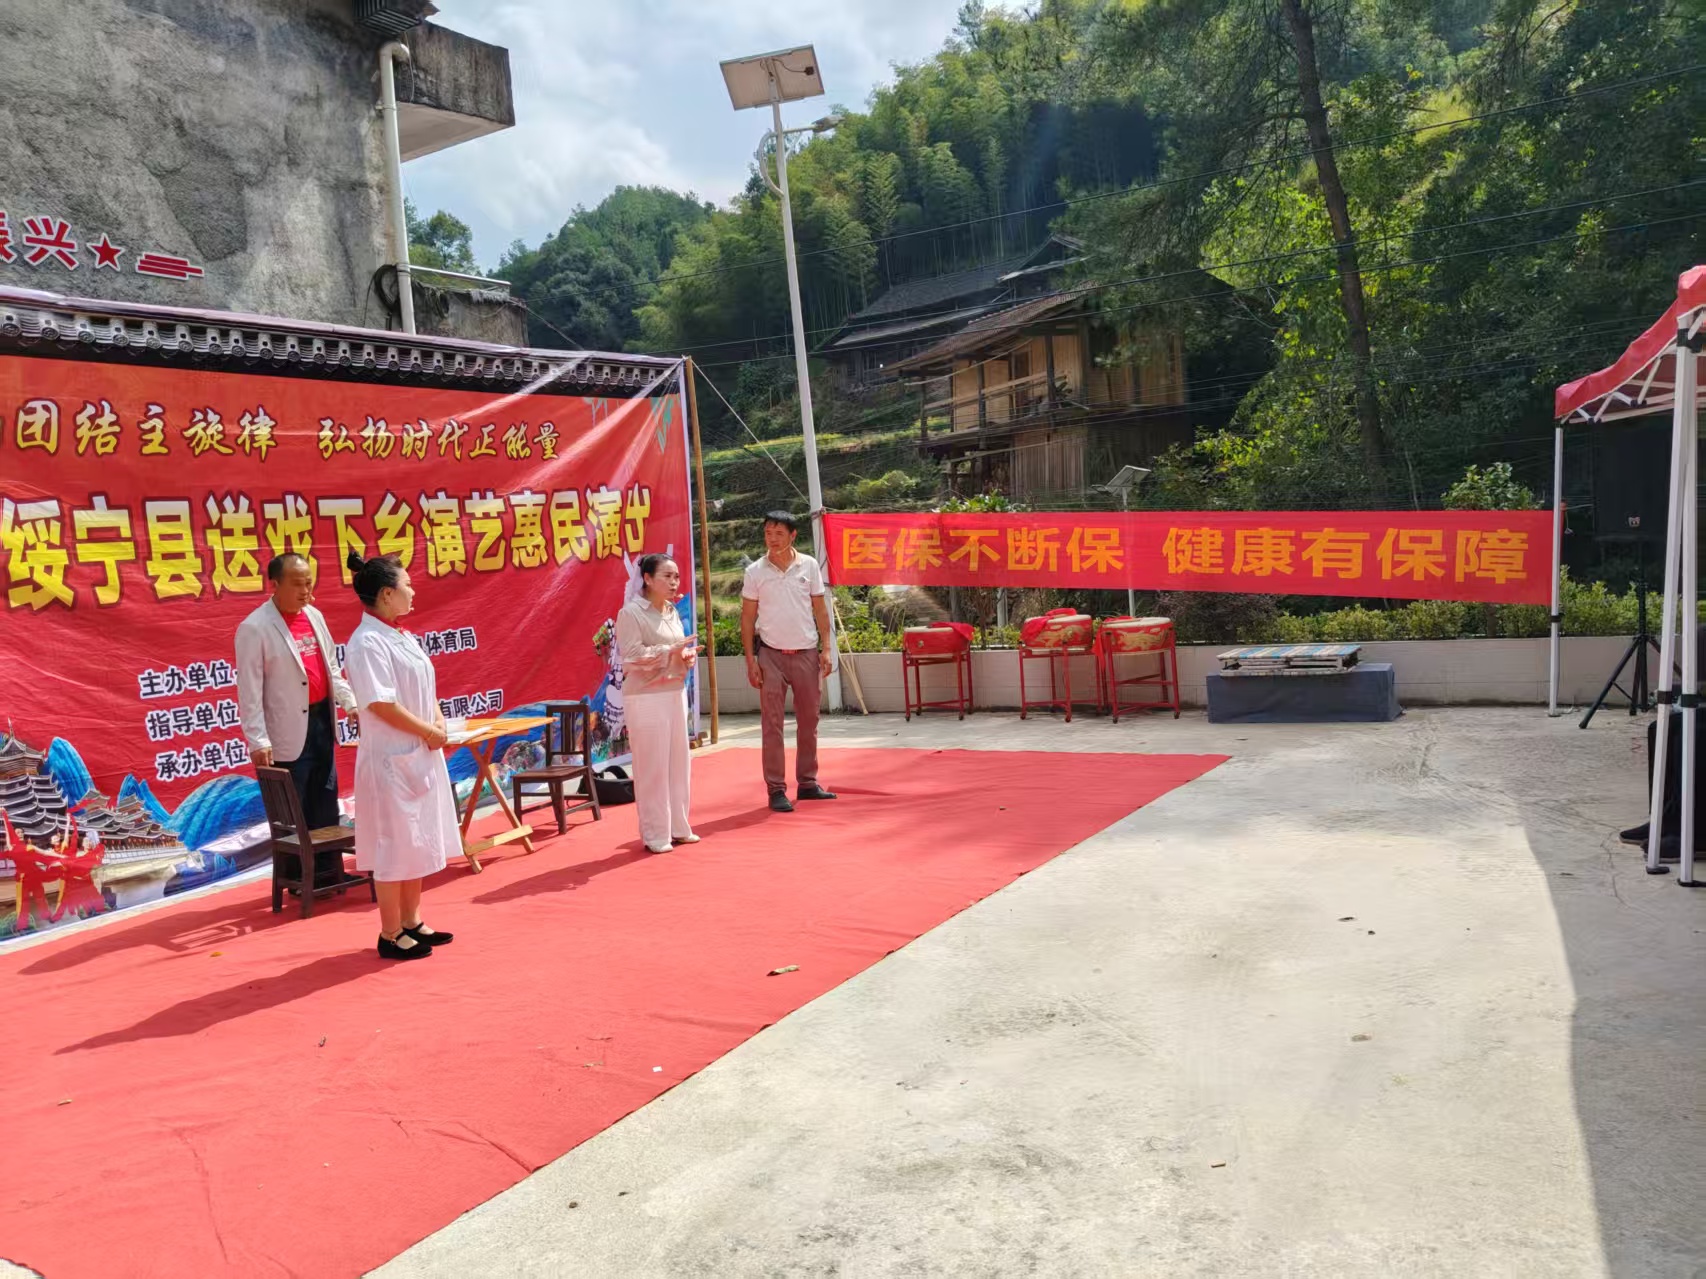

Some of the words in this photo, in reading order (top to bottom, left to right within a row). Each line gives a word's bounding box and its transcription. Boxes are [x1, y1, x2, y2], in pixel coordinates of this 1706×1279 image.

[16, 399, 278, 461] 团结主旋律
[317, 415, 561, 460] 弘扬时代正能量
[1, 481, 652, 612] 绥宁县送戏下乡演艺惠民演出
[842, 527, 1125, 573] 医保不断保
[1161, 526, 1529, 585] 健康有保障
[139, 660, 234, 698] 主办单位
[145, 699, 240, 740] 指导单位
[156, 739, 249, 781] 承办单位
[439, 689, 503, 719] 有限公司
